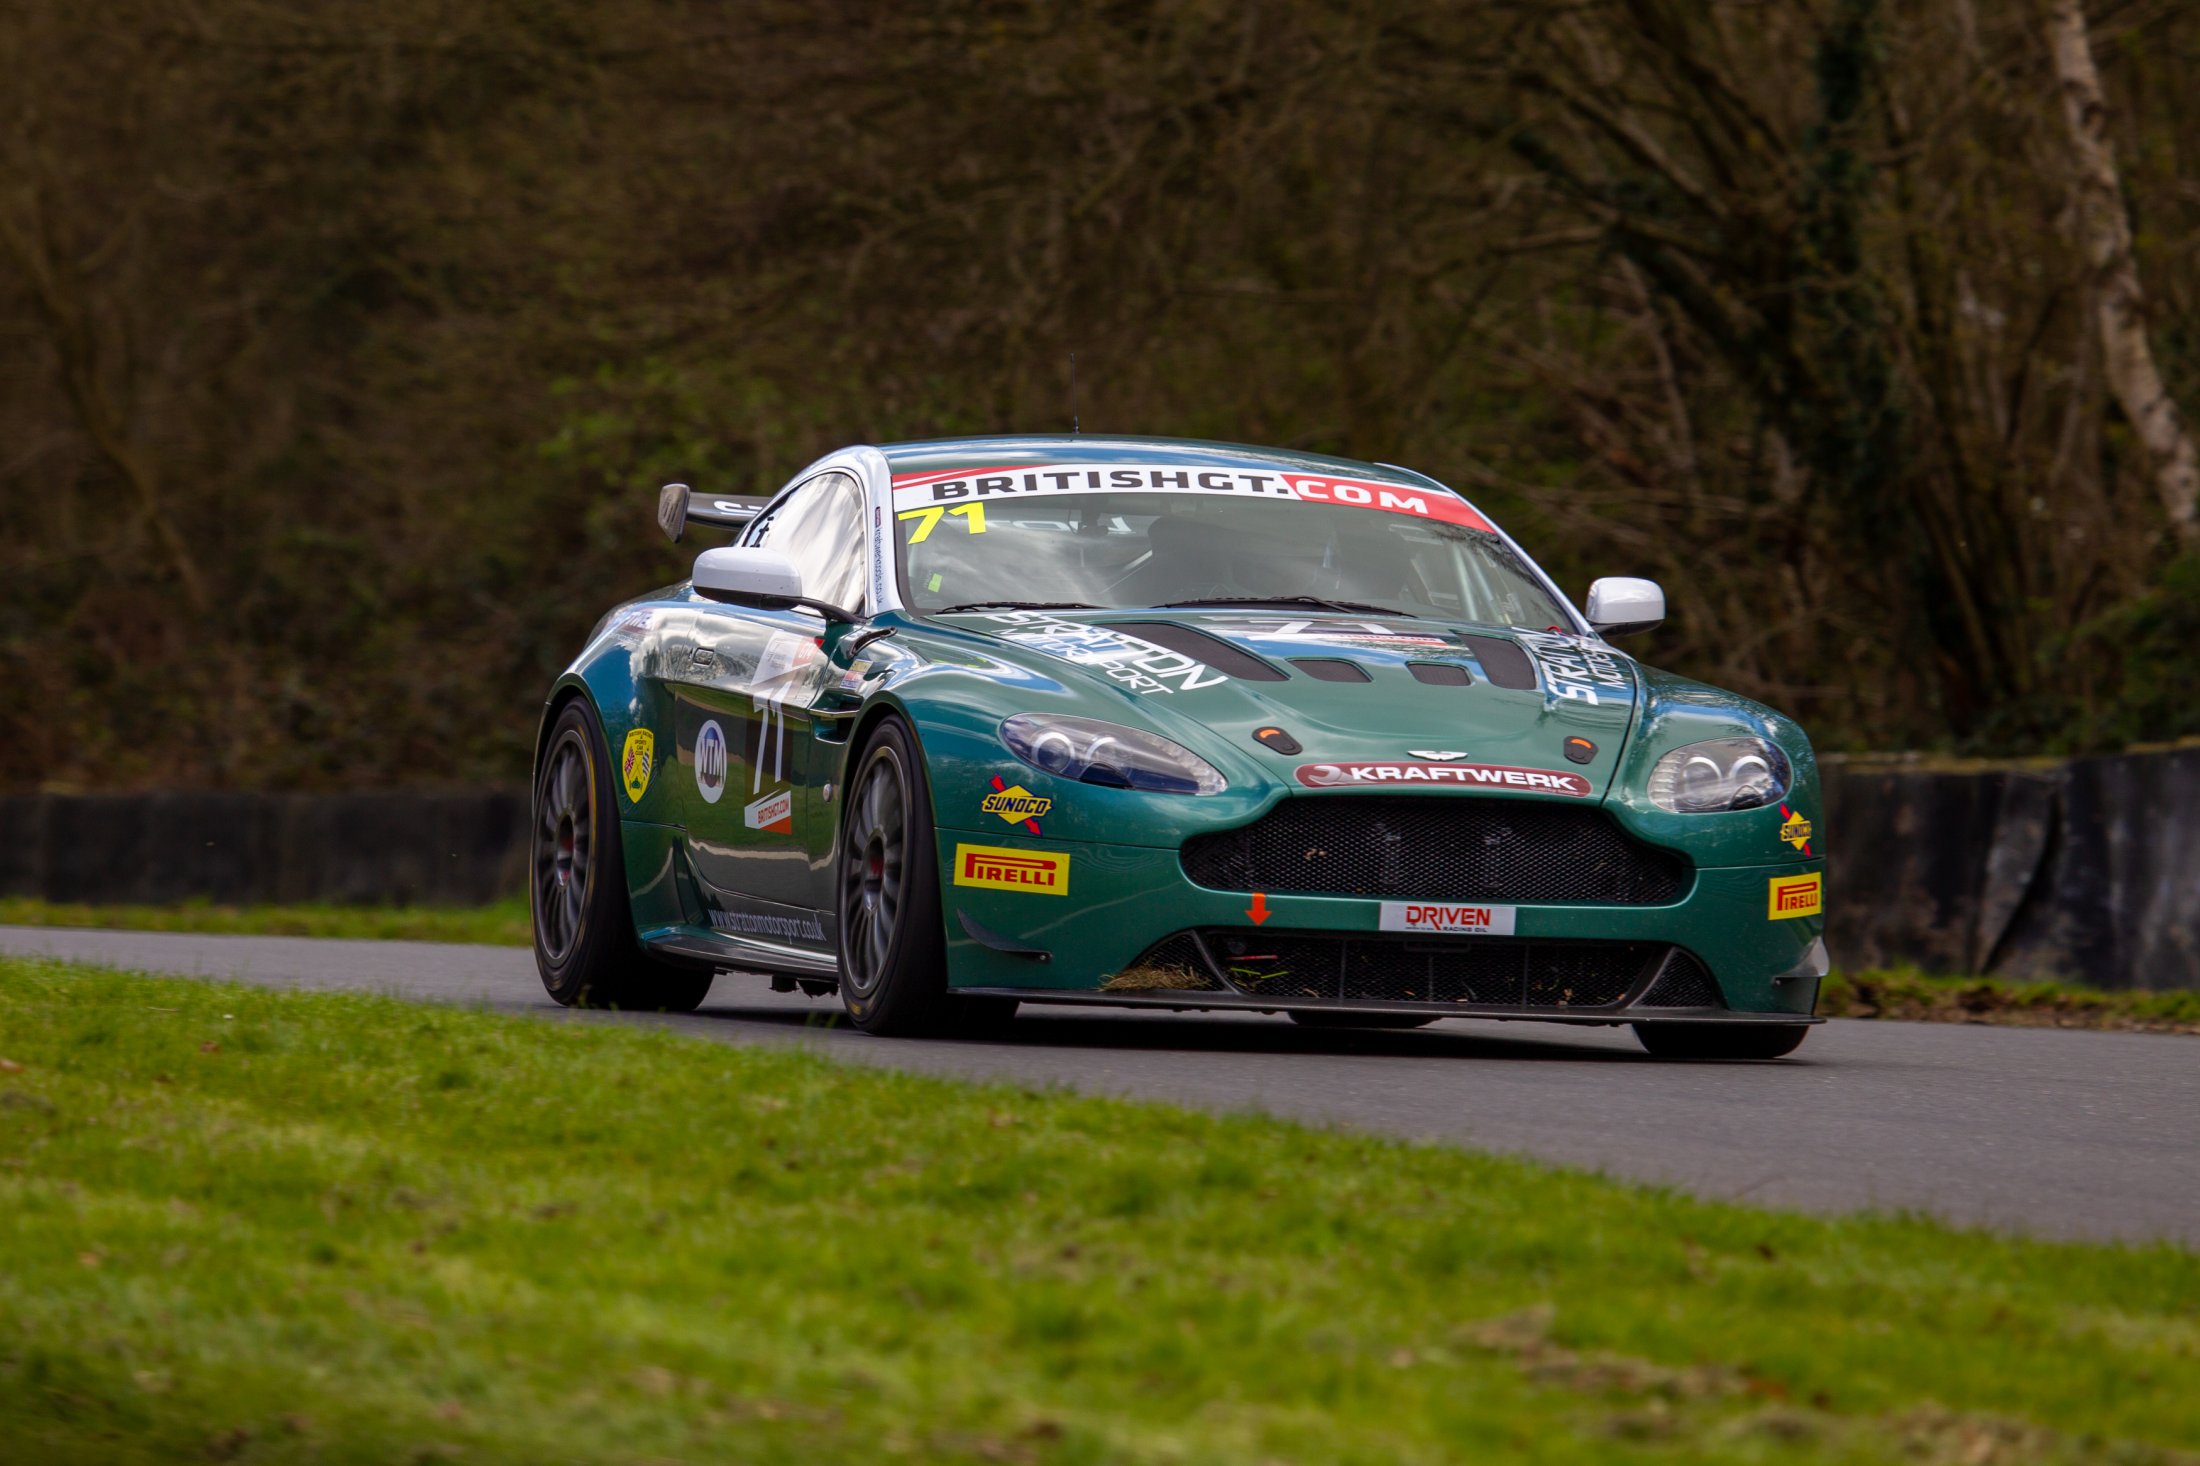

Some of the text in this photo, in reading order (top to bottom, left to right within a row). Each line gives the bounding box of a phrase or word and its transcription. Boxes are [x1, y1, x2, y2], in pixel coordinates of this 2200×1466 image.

[932, 470, 1429, 514] BRITISHGT.COM
[898, 502, 986, 545] 71
[752, 681, 793, 795] 71
[1350, 766, 1579, 791] KRAFTWERK
[984, 796, 1049, 814] SUNOCO
[964, 853, 1057, 886] PIRELLI
[1777, 881, 1818, 911] PIRELLI
[1406, 906, 1491, 930] DRIVEN
